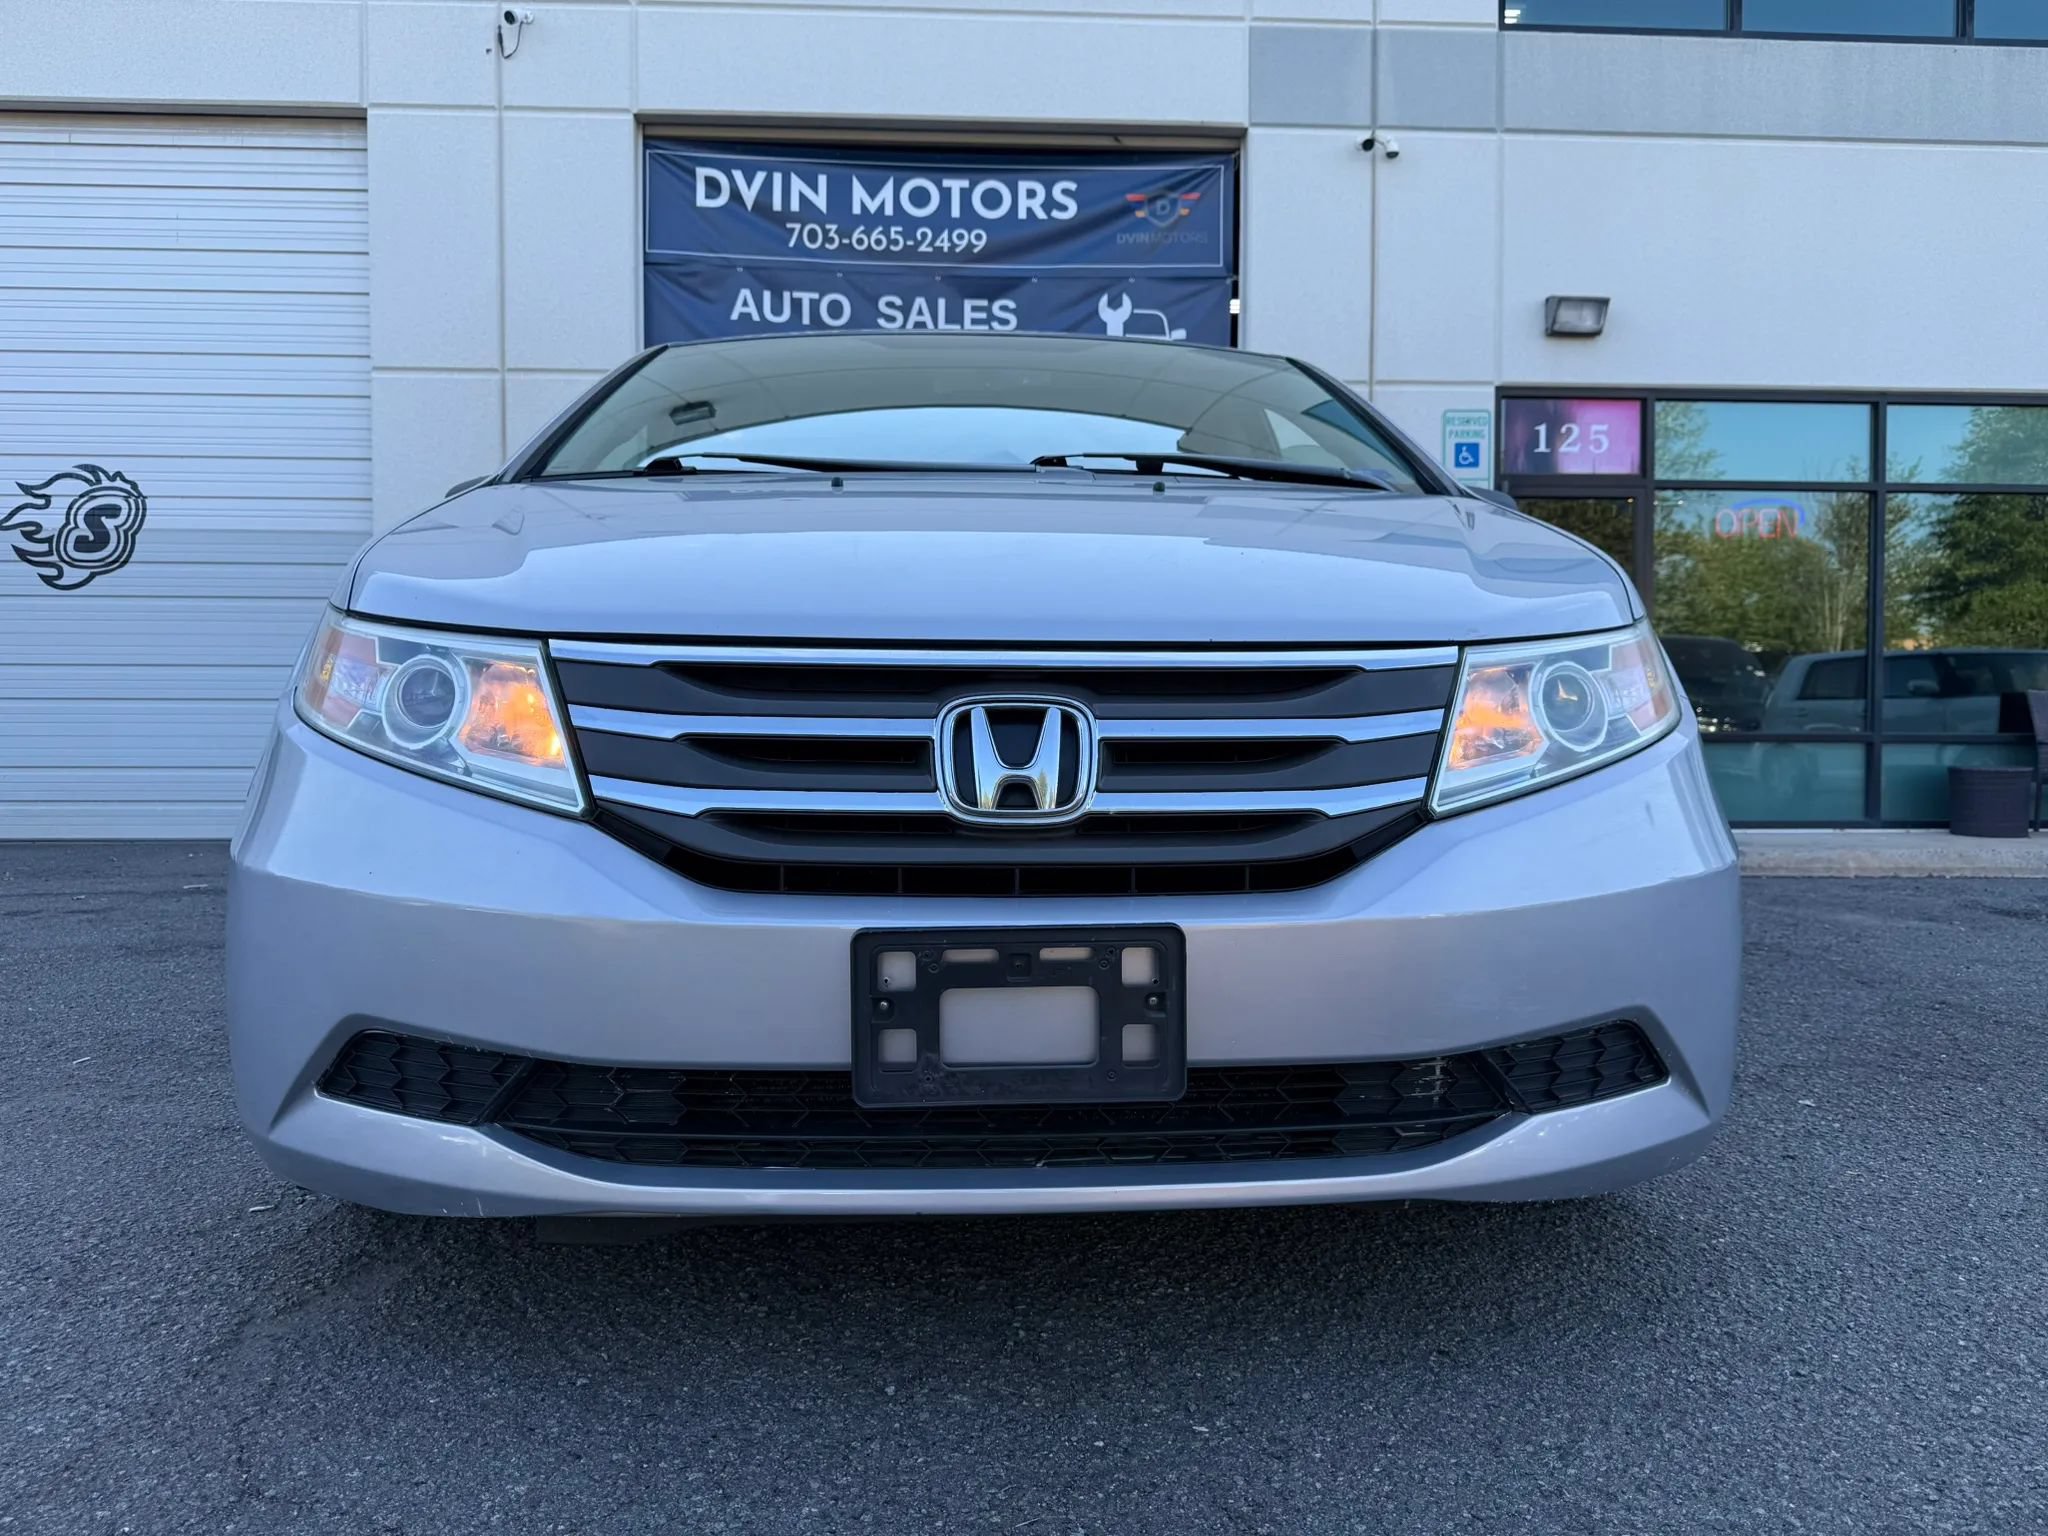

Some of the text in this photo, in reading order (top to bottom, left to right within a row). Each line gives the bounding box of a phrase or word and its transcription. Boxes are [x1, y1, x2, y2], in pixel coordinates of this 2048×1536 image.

[695, 166, 1079, 221] DVIN MOTORS
[785, 222, 988, 255] 703-665-2499
[730, 287, 1018, 332] AUTO SALES
[1532, 422, 1610, 455] 125
[1715, 508, 1798, 539] OPEN
